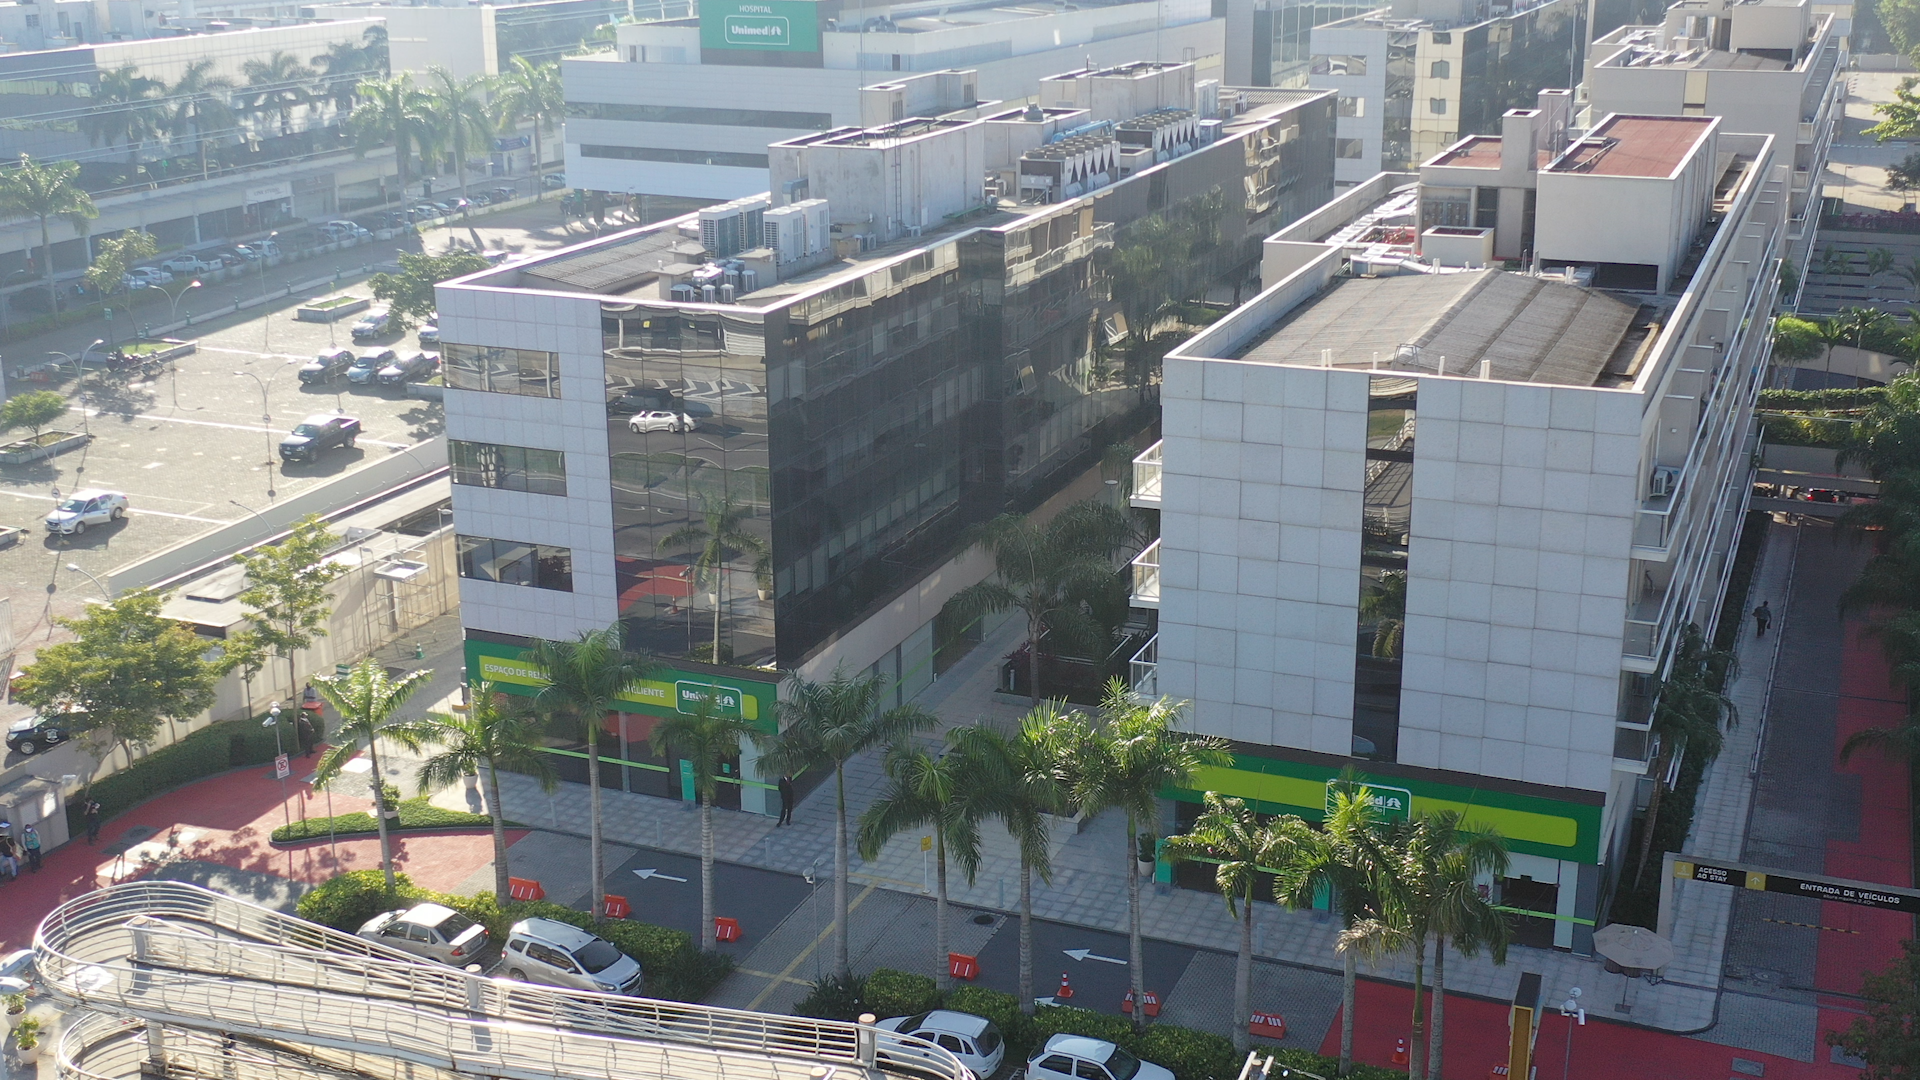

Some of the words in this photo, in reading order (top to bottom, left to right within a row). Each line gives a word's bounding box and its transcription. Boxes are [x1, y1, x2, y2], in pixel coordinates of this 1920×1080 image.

[739, 5, 773, 14] HOSPITAL
[731, 25, 768, 36] Unimed
[484, 664, 515, 676] ESPAÇO
[515, 668, 527, 677] DE
[1698, 867, 1727, 876] ACESSO
[1709, 874, 1728, 882] STAY
[1800, 883, 1840, 895] ENTRADA
[1843, 889, 1855, 897] DE
[1858, 891, 1900, 904] VEÍCULOS
